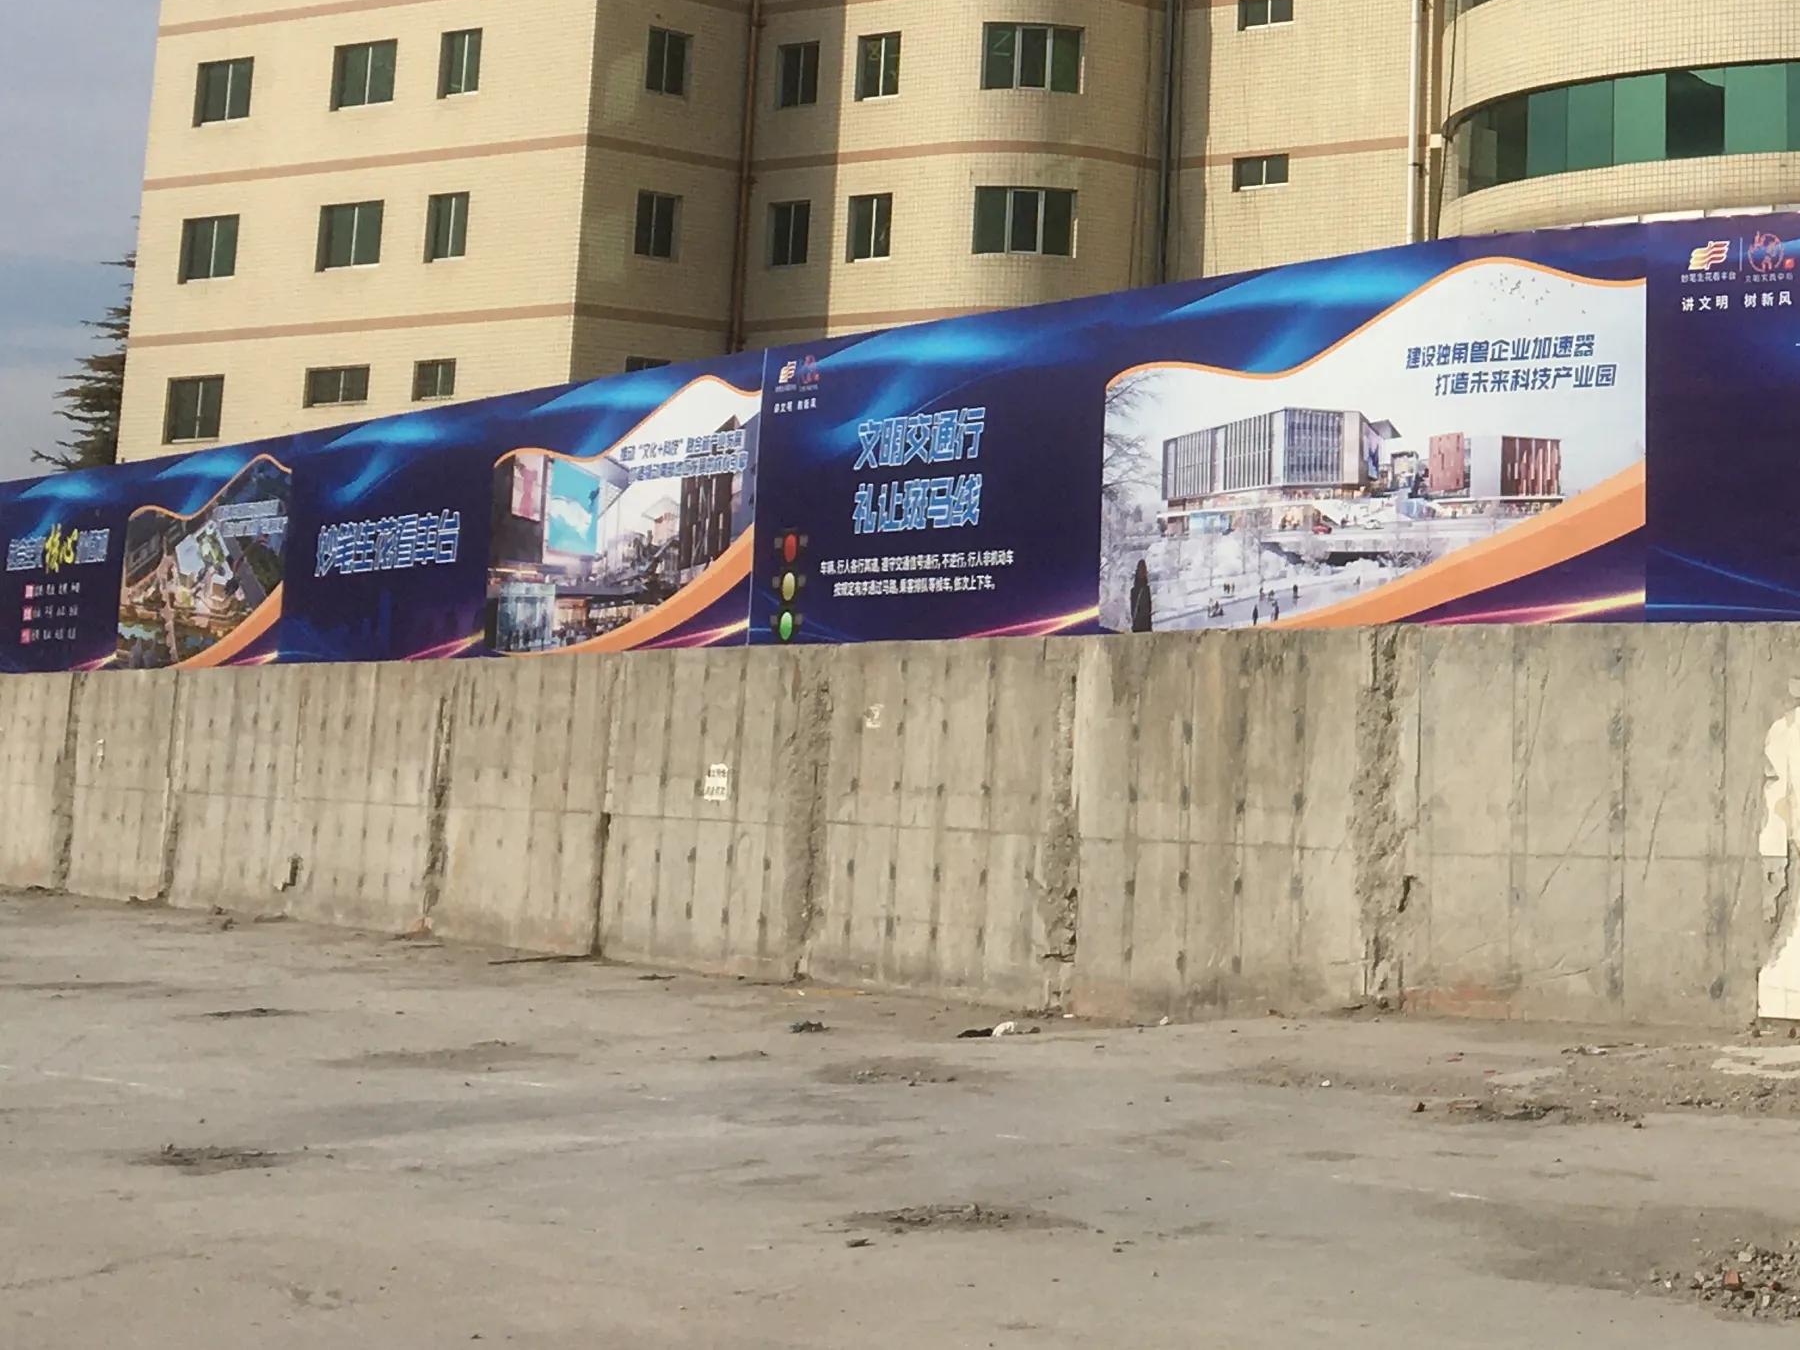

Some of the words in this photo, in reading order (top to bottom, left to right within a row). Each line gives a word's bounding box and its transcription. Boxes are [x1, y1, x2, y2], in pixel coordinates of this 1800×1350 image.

[1681, 295, 1729, 312] 讲文明
[1744, 290, 1792, 309] 树新风
[1405, 333, 1596, 370] 建设独角兽企业加速器
[1434, 363, 1618, 397] 打造未来科技产业园
[853, 407, 986, 470] 文明交通行
[852, 473, 982, 535] 礼让斑马线
[314, 508, 460, 578] 妙笔生花看丰台
